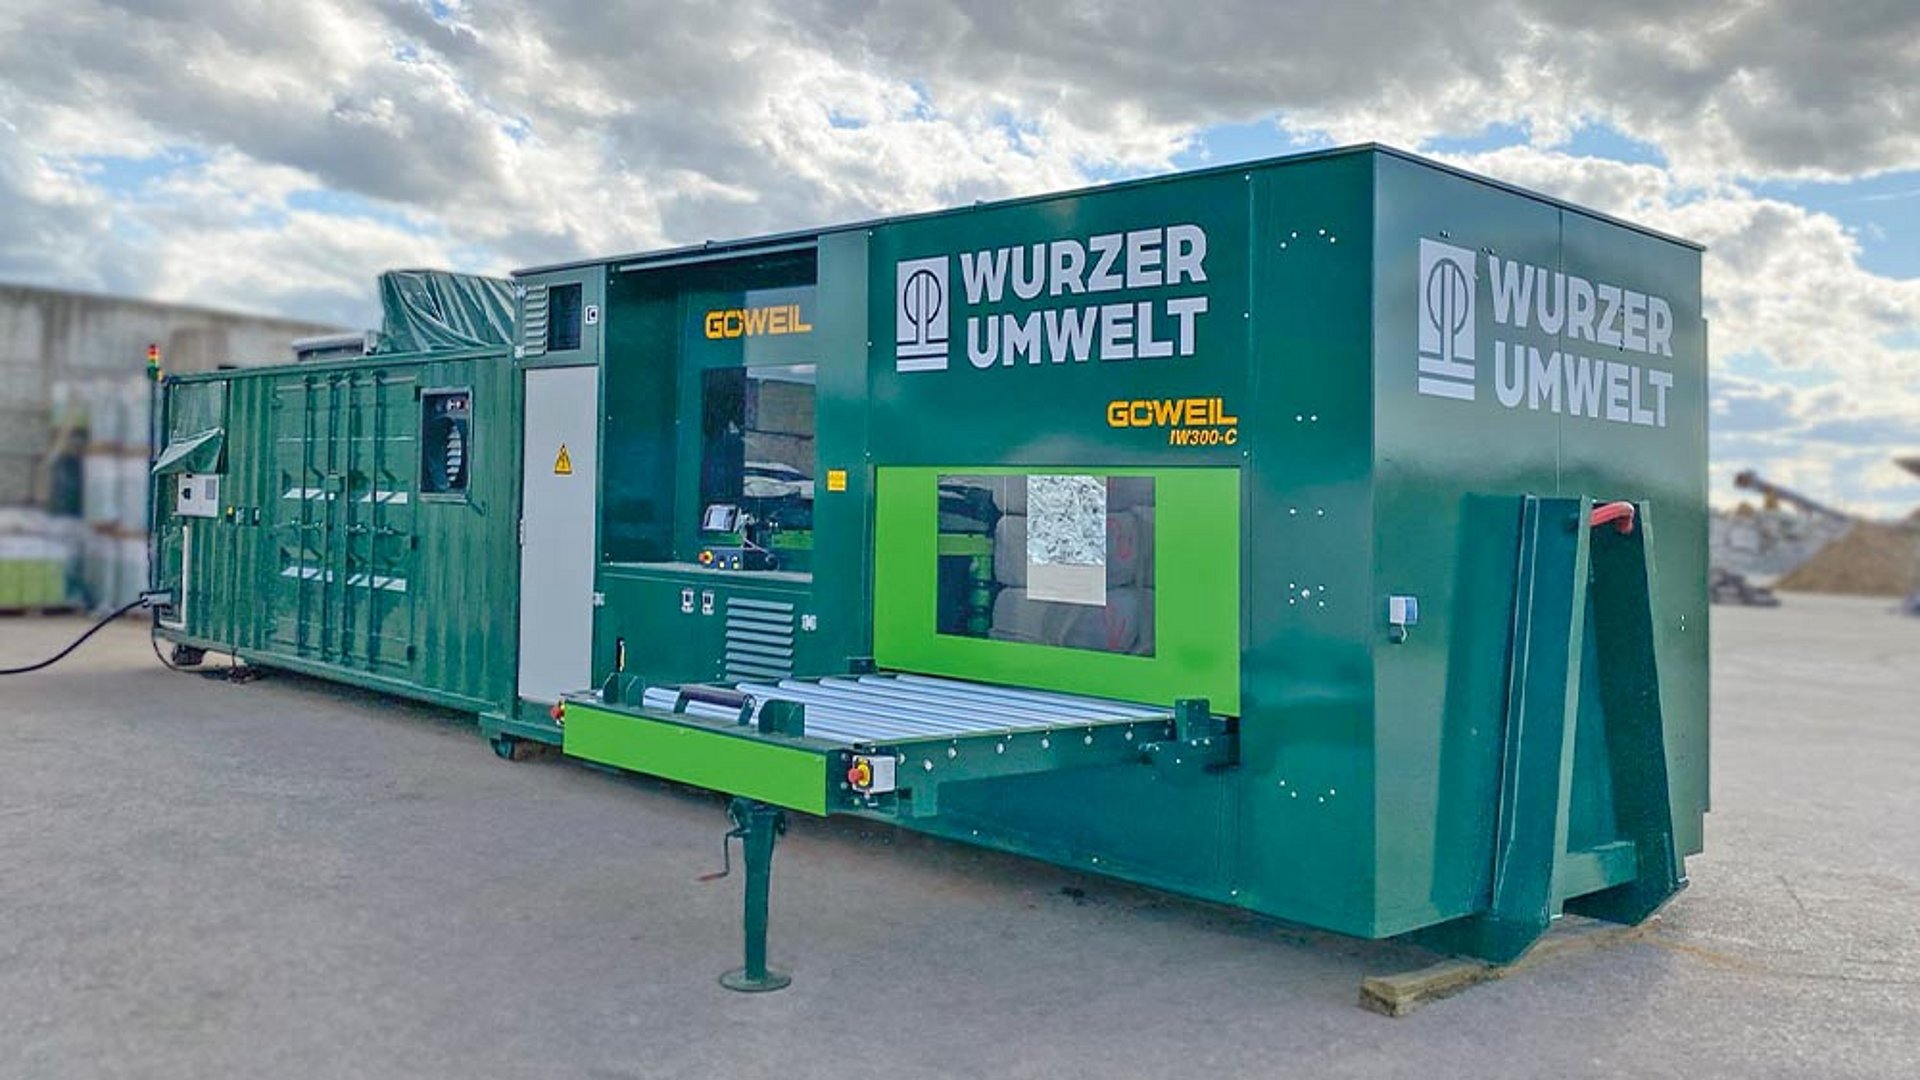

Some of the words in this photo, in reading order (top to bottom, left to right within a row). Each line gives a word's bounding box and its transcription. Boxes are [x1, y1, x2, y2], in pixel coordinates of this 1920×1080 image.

[960, 224, 1207, 304] WURZER
[967, 296, 1208, 368] UMWELT
[1489, 255, 1673, 357] WURZER
[1495, 340, 1673, 427] UMWELT
[1169, 428, 1237, 445] IW300-C
